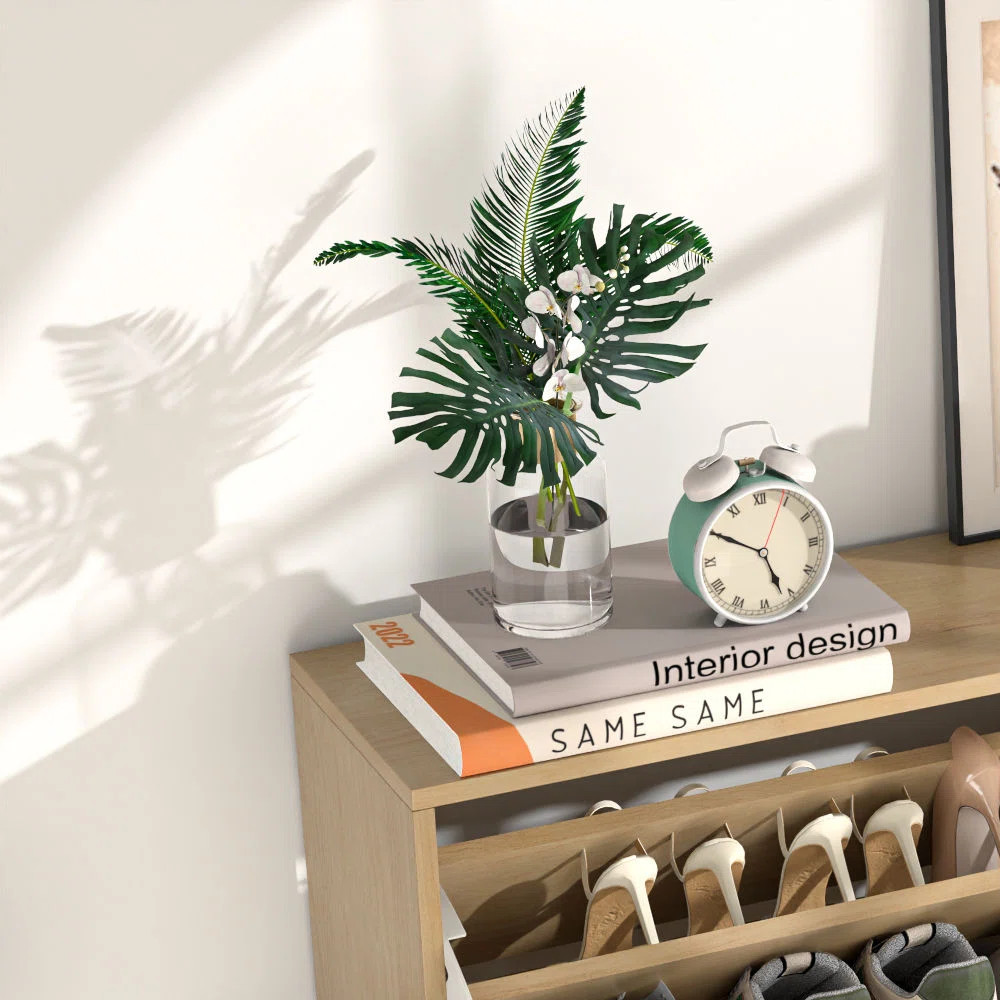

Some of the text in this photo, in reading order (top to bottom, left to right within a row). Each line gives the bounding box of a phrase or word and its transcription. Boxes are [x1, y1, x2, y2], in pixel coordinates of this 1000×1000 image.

[752, 492, 767, 506] XII
[726, 503, 741, 518] XI
[808, 536, 819, 548] III
[732, 595, 745, 609] VII
[760, 599, 770, 610] VI
[368, 621, 416, 648] 2022
[652, 622, 898, 686] Interior design
[551, 688, 765, 753] SAME SAME
